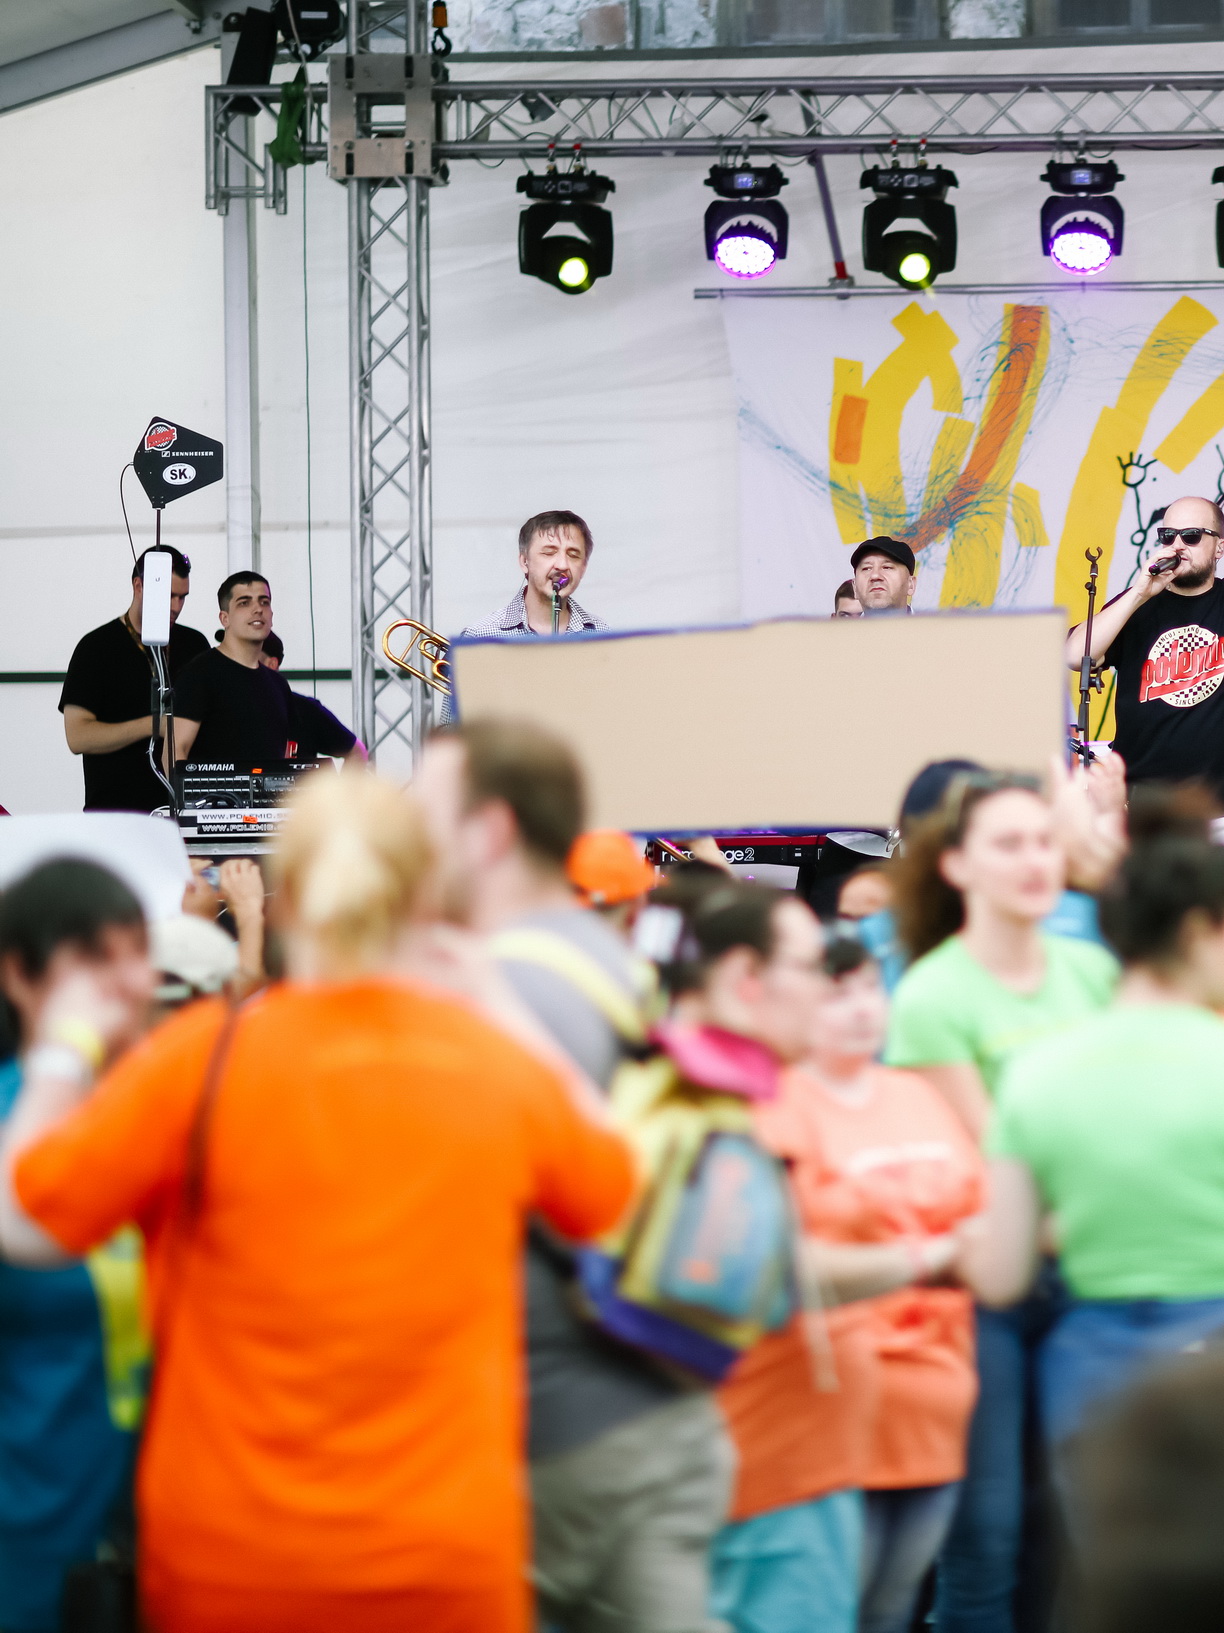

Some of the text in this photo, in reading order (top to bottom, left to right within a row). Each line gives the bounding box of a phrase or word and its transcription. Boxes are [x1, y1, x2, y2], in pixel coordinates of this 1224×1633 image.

[170, 468, 188, 480] SK
[1156, 631, 1176, 649] TANCUJ
[1175, 697, 1196, 705] SINCE
[197, 763, 235, 771] YAMAHA
